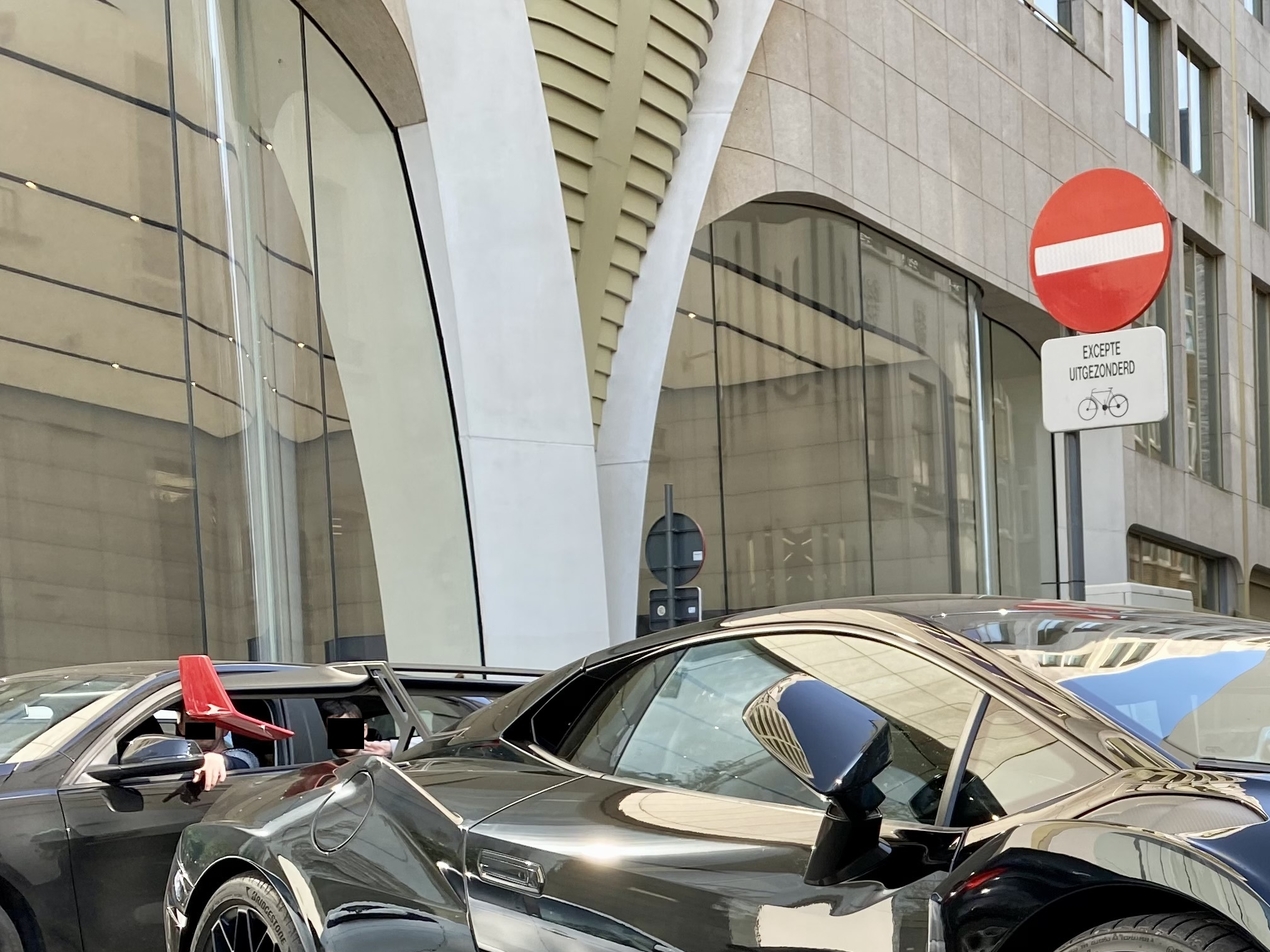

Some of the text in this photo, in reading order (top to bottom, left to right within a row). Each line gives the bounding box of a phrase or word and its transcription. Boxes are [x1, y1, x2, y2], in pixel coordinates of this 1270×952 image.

[1082, 340, 1121, 359] EXCEPTE
[1068, 359, 1135, 381] UITGEZONDERD
[251, 890, 287, 946] BRIDGESTONE
